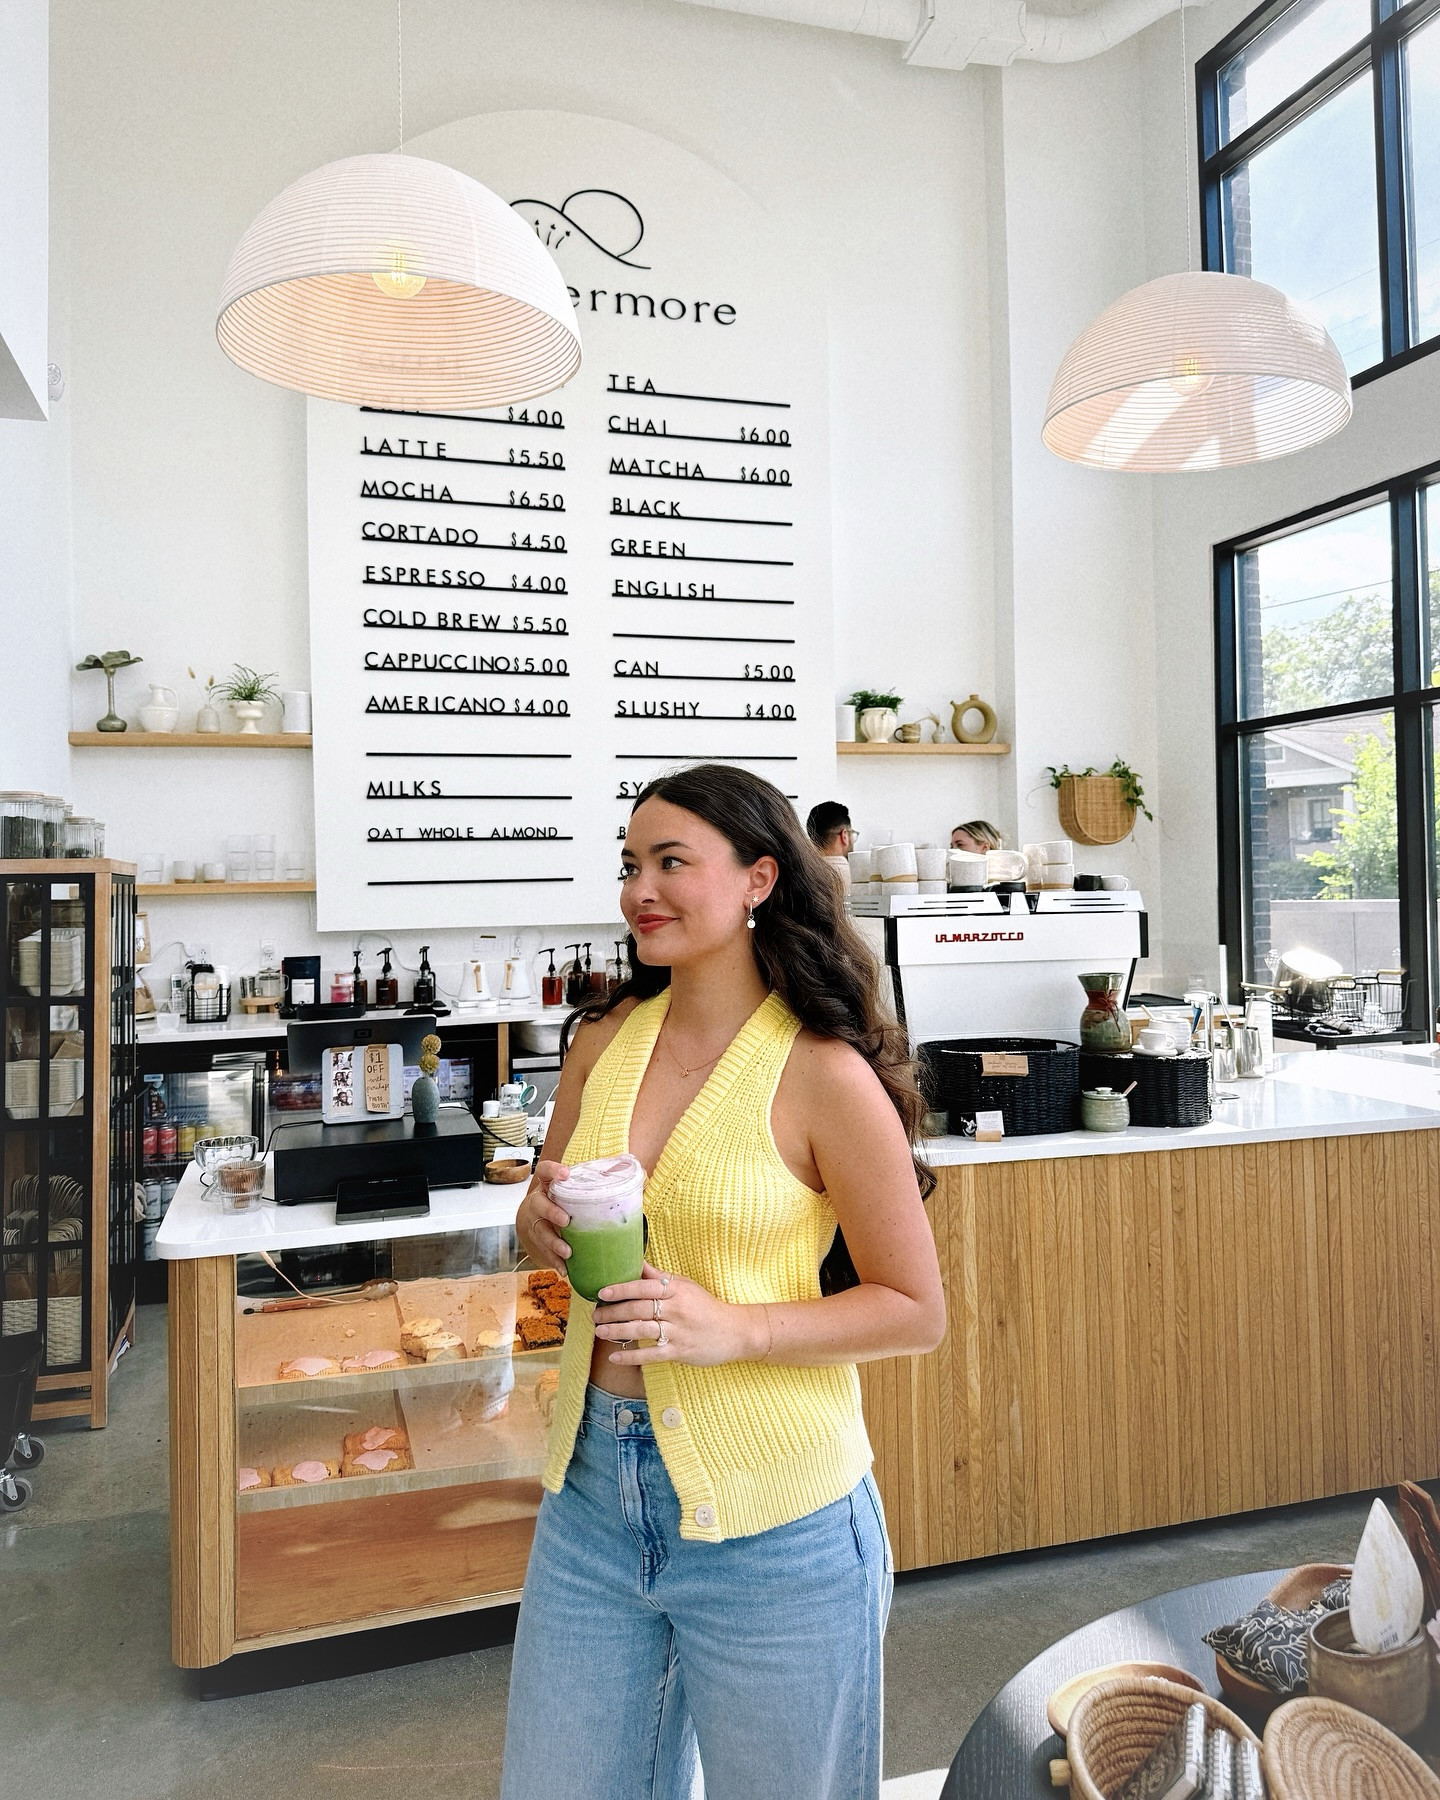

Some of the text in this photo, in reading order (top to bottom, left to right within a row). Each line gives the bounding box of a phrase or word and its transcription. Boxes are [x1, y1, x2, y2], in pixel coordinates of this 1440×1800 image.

[566, 286, 737, 325] ermore
[608, 374, 657, 393] TEA
[508, 406, 563, 427] $4.00
[608, 415, 790, 445] CHAI $6.00
[363, 436, 564, 468] LATTE $5.50
[609, 457, 790, 485] MATCHA $6.00
[360, 480, 565, 510] MOCHA $6.50
[612, 497, 682, 517] BLACK
[361, 521, 566, 551] CORTADO $4.50
[611, 538, 686, 558] GREEN
[365, 565, 567, 593] ESPRESSO $4.00
[614, 579, 716, 600] ENGLISH
[363, 608, 568, 634] COLD BREW $5.50
[364, 651, 569, 675] CAPPUCCINO $5.00
[614, 660, 795, 681] CAN $5.00
[365, 695, 570, 716] AMERICANO $4.00
[617, 700, 796, 720] SLUSHY $4.00
[367, 780, 443, 797] MILKS
[368, 826, 559, 840] OAT WHOLE ALMOND
[369, 1052, 383, 1063] $1
[366, 1064, 385, 1074] OFF
